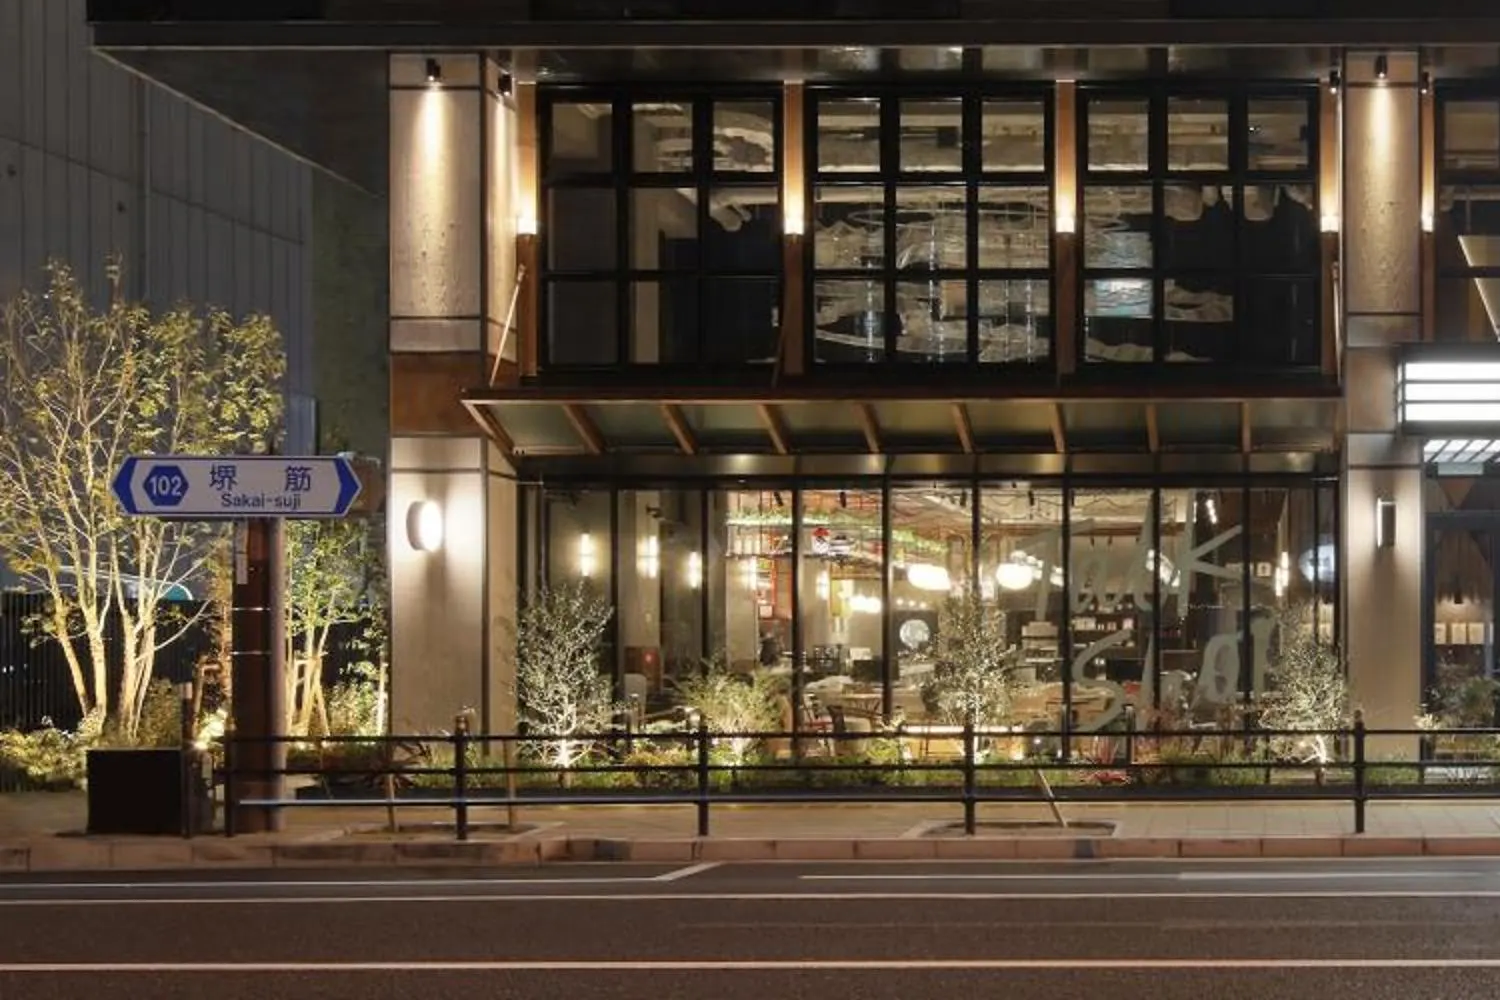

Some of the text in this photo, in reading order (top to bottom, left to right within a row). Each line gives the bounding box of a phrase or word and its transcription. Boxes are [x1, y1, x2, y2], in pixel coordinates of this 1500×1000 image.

[150, 475, 182, 497] 102
[209, 465, 312, 492] 堺筋
[221, 494, 302, 509] Sakai-suji
